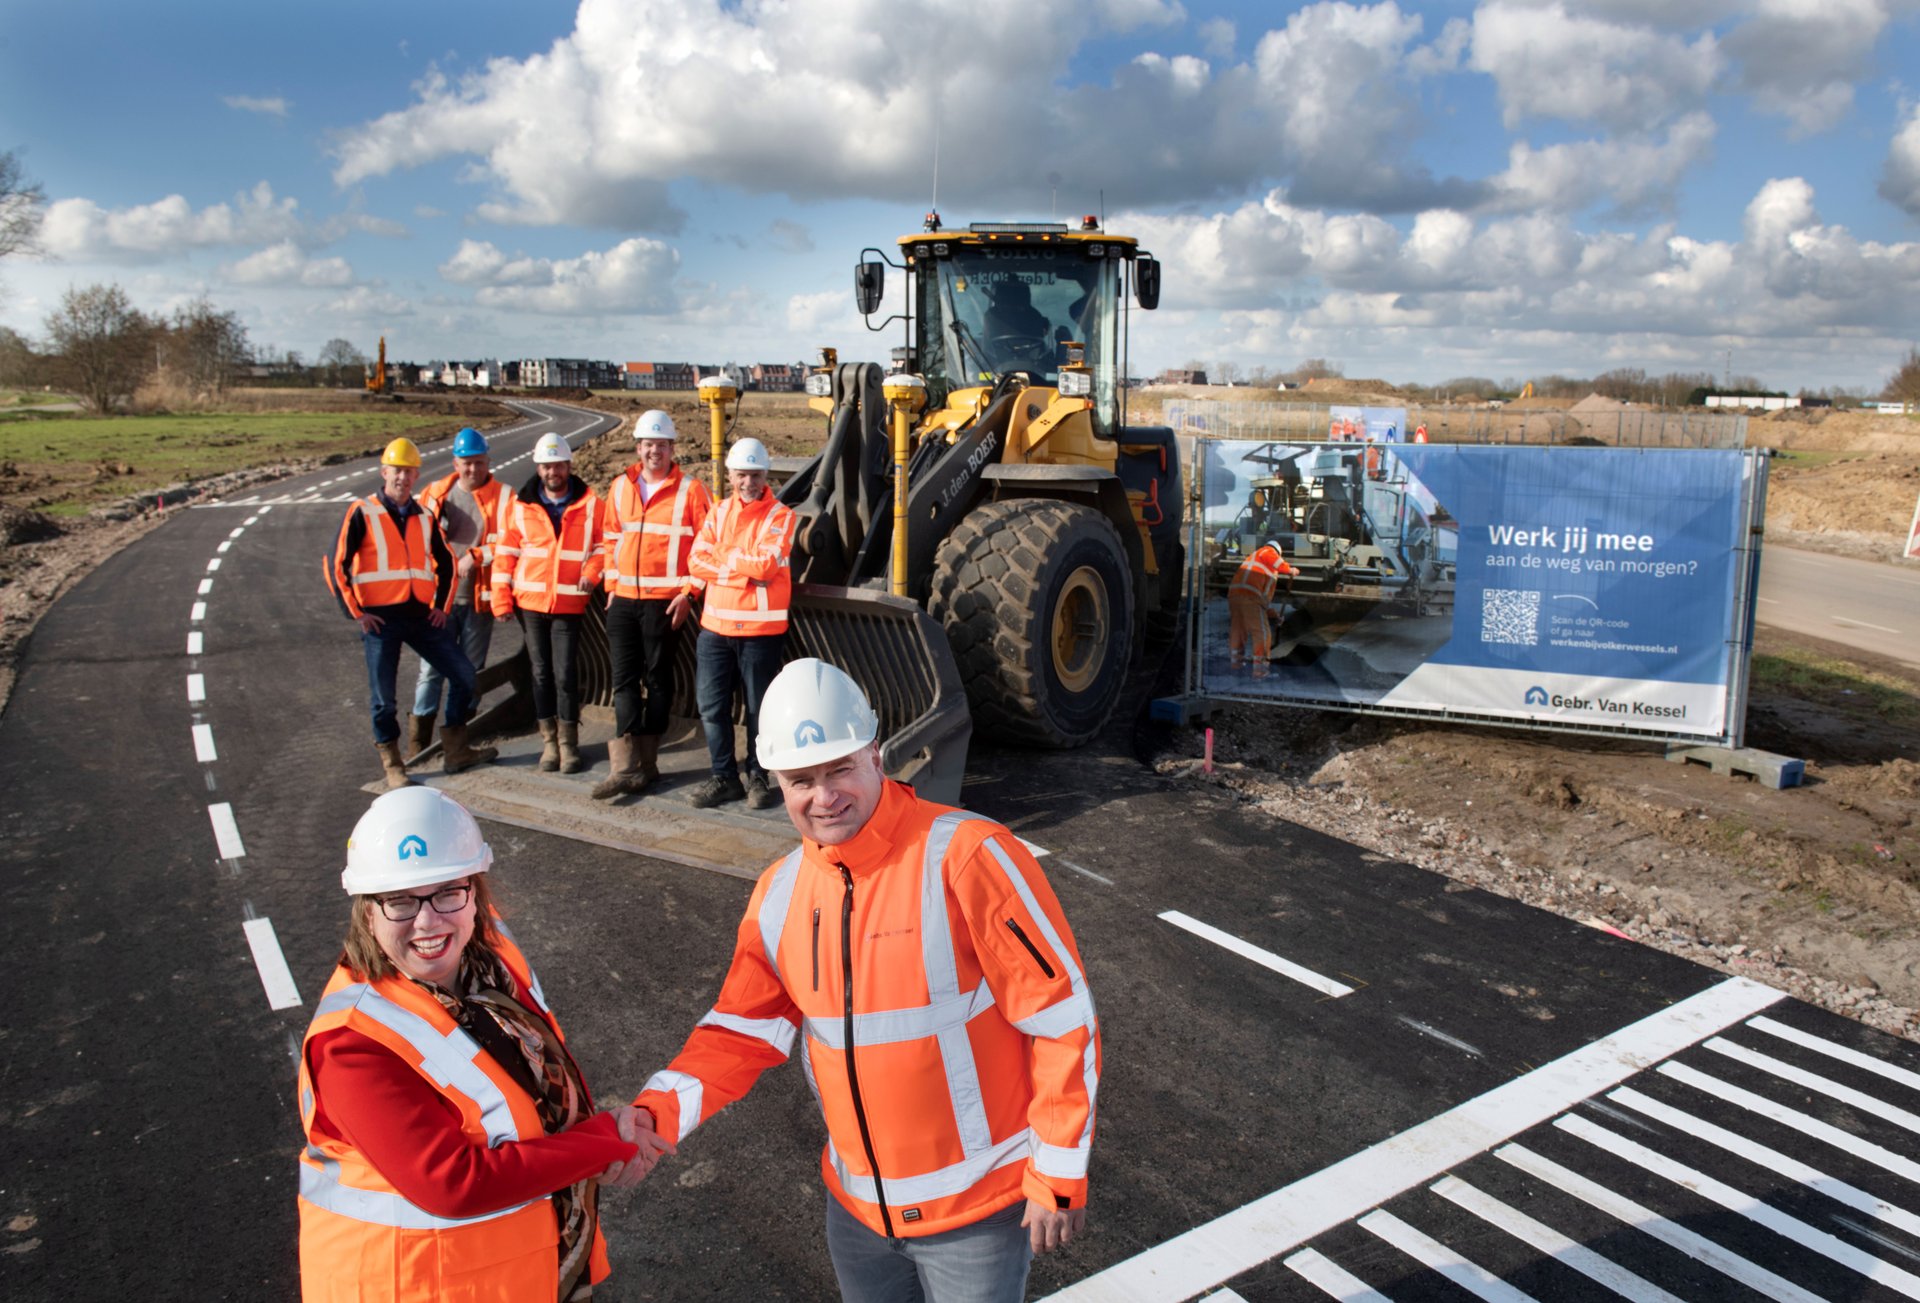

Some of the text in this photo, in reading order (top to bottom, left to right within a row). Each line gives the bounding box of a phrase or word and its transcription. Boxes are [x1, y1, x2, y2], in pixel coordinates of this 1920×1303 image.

[950, 469, 970, 497] den
[968, 431, 997, 474] BOER
[1488, 525, 1654, 553] Werk jij mee
[1486, 554, 1698, 578] aan de weg van morgen?
[1550, 627, 1560, 635] of
[1562, 629, 1573, 637] ga
[1551, 615, 1630, 629] Scan de QR-code
[1550, 638, 1678, 654] werkenbijvolkerwessels.nl
[1552, 694, 1687, 718] Gebr. Van Kessel
